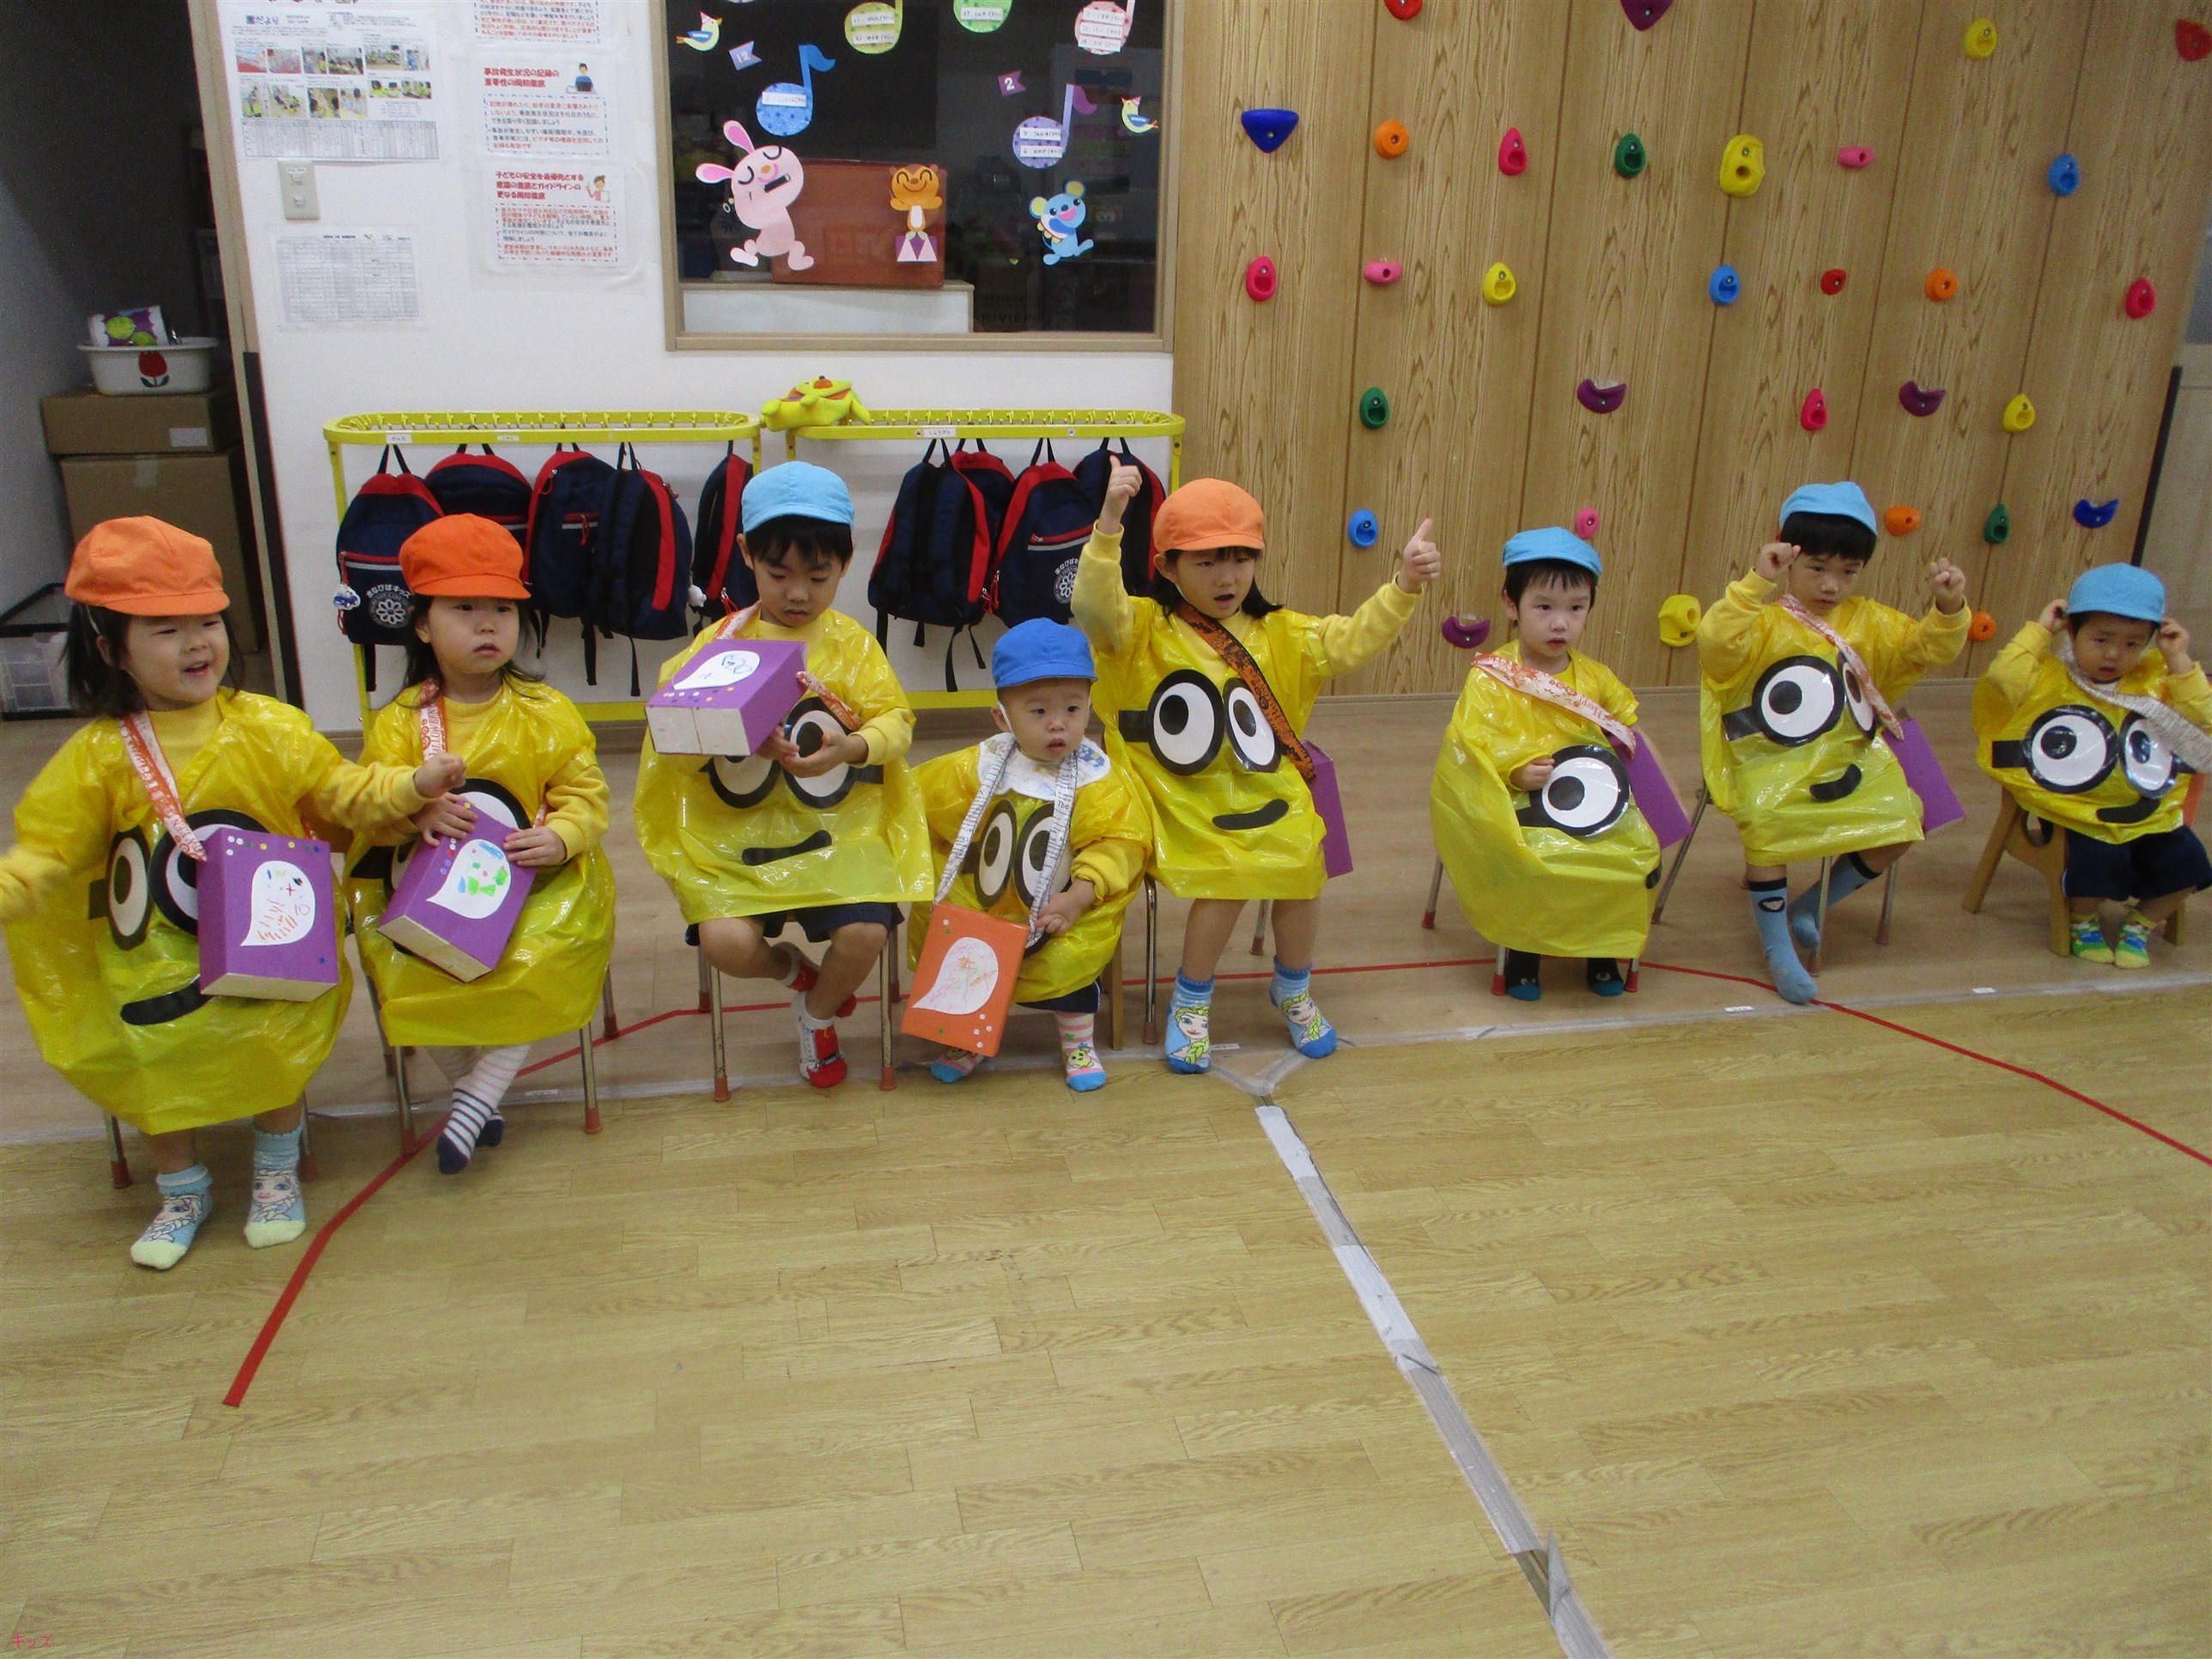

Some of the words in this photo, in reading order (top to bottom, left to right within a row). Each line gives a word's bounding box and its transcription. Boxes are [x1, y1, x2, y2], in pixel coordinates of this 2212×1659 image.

[1005, 77, 1015, 91] 2
[495, 172, 584, 181] 子どもの安全を最優先とする
